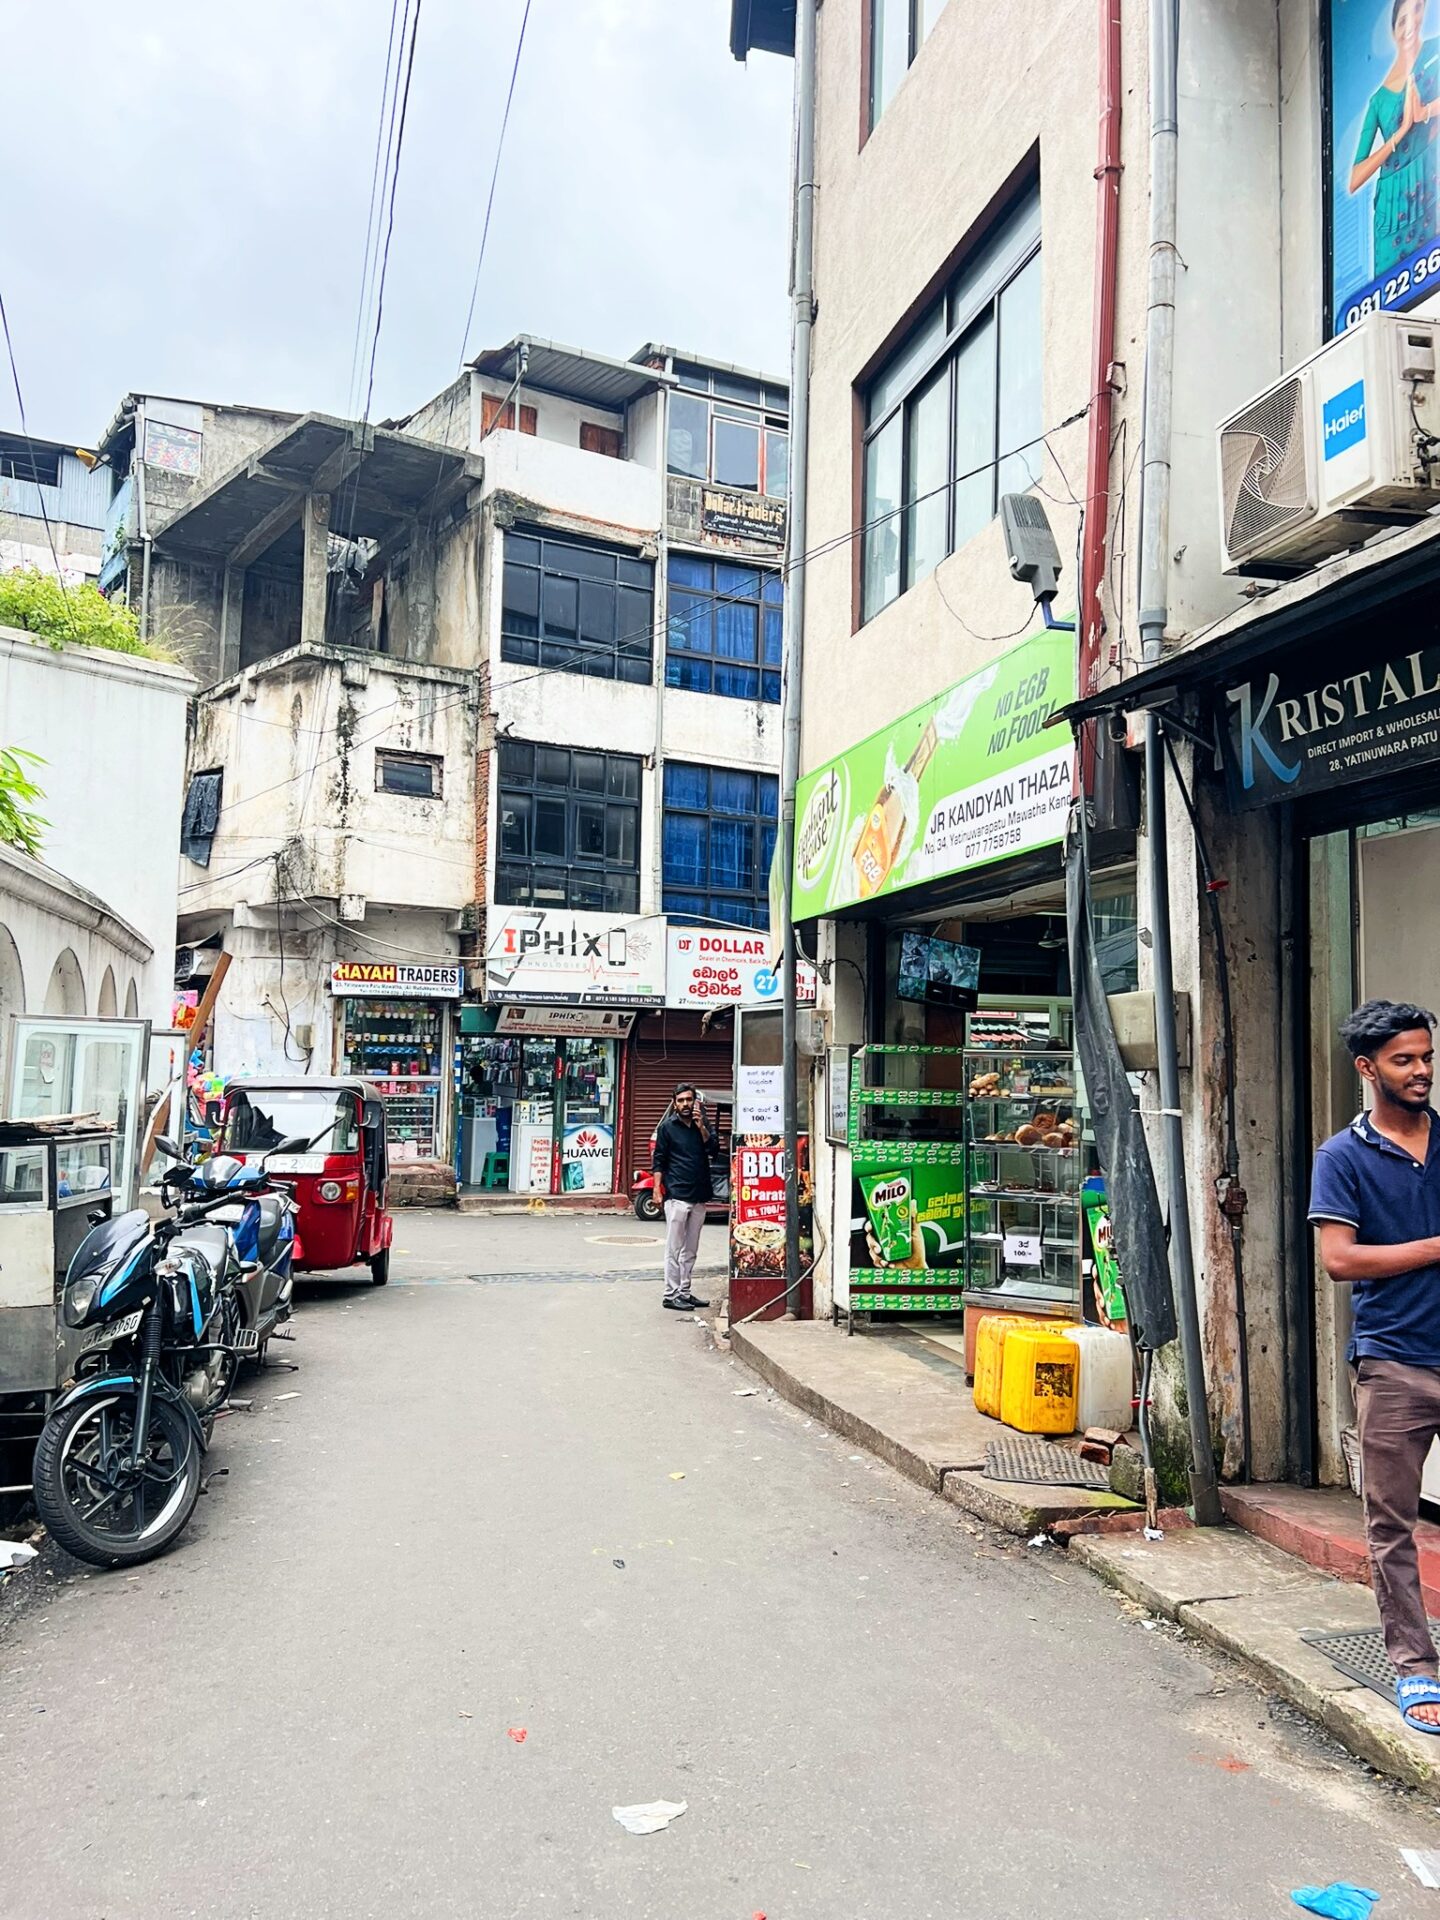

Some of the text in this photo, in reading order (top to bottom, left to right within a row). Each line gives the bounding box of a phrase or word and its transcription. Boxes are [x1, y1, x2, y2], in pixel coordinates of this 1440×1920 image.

[1345, 289, 1382, 329] 081
[1384, 270, 1410, 304] 22
[1324, 404, 1365, 440] Haier
[993, 667, 1050, 721] NO EGB
[1226, 650, 1440, 790] KRISTAL
[987, 727, 1008, 757] NO
[1307, 741, 1338, 759] DIRECT
[1338, 728, 1374, 750] IMPORT
[1376, 726, 1385, 738] &
[1328, 730, 1439, 773] 28, YATINUWARA PATU
[930, 812, 946, 834] JR
[948, 782, 1015, 829] KANDYAN
[1007, 803, 1047, 826] Mawatha
[1048, 792, 1072, 812] Kand
[965, 828, 1021, 859] 077 7758758
[504, 918, 602, 957] IPHIX
[699, 937, 765, 955] DOLLAR
[338, 964, 457, 984] HAYAH TRADERS
[756, 975, 775, 990] 27
[562, 1148, 612, 1158] HUAWEI
[743, 1151, 785, 1180] BBQ
[742, 1185, 751, 1201] 6
[874, 1184, 906, 1204] MILO
